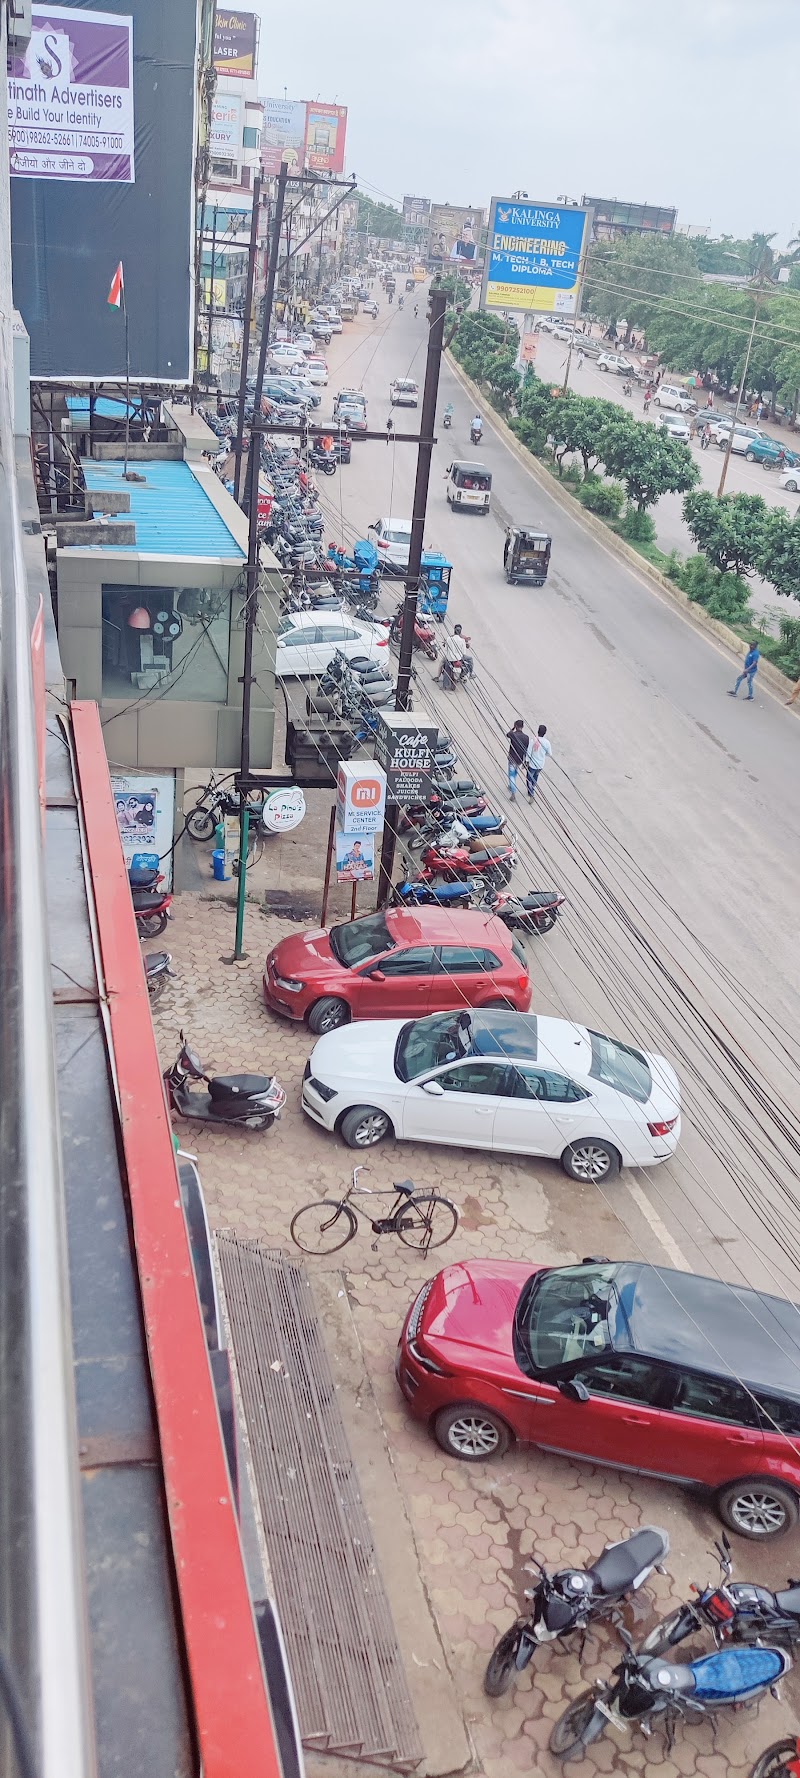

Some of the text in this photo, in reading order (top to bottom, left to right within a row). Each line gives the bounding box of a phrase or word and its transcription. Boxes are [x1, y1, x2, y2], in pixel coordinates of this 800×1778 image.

[213, 46, 238, 57] LASER
[8, 81, 122, 109] tinath Advertisers
[16, 106, 40, 121] Build
[43, 108, 63, 123] Your
[67, 110, 102, 128] Identity
[78, 159, 86, 171] दो
[512, 207, 561, 222] KALINGA
[511, 216, 560, 229] UNIVERSITY
[493, 233, 566, 257] ENGINEERING
[492, 253, 502, 262] M.
[506, 256, 528, 264] TECH
[540, 258, 548, 266] B.
[551, 259, 575, 269] TECH
[511, 264, 553, 275] DIPLOMA
[394, 748, 430, 758] KULFI
[390, 758, 431, 768] HOUSE
